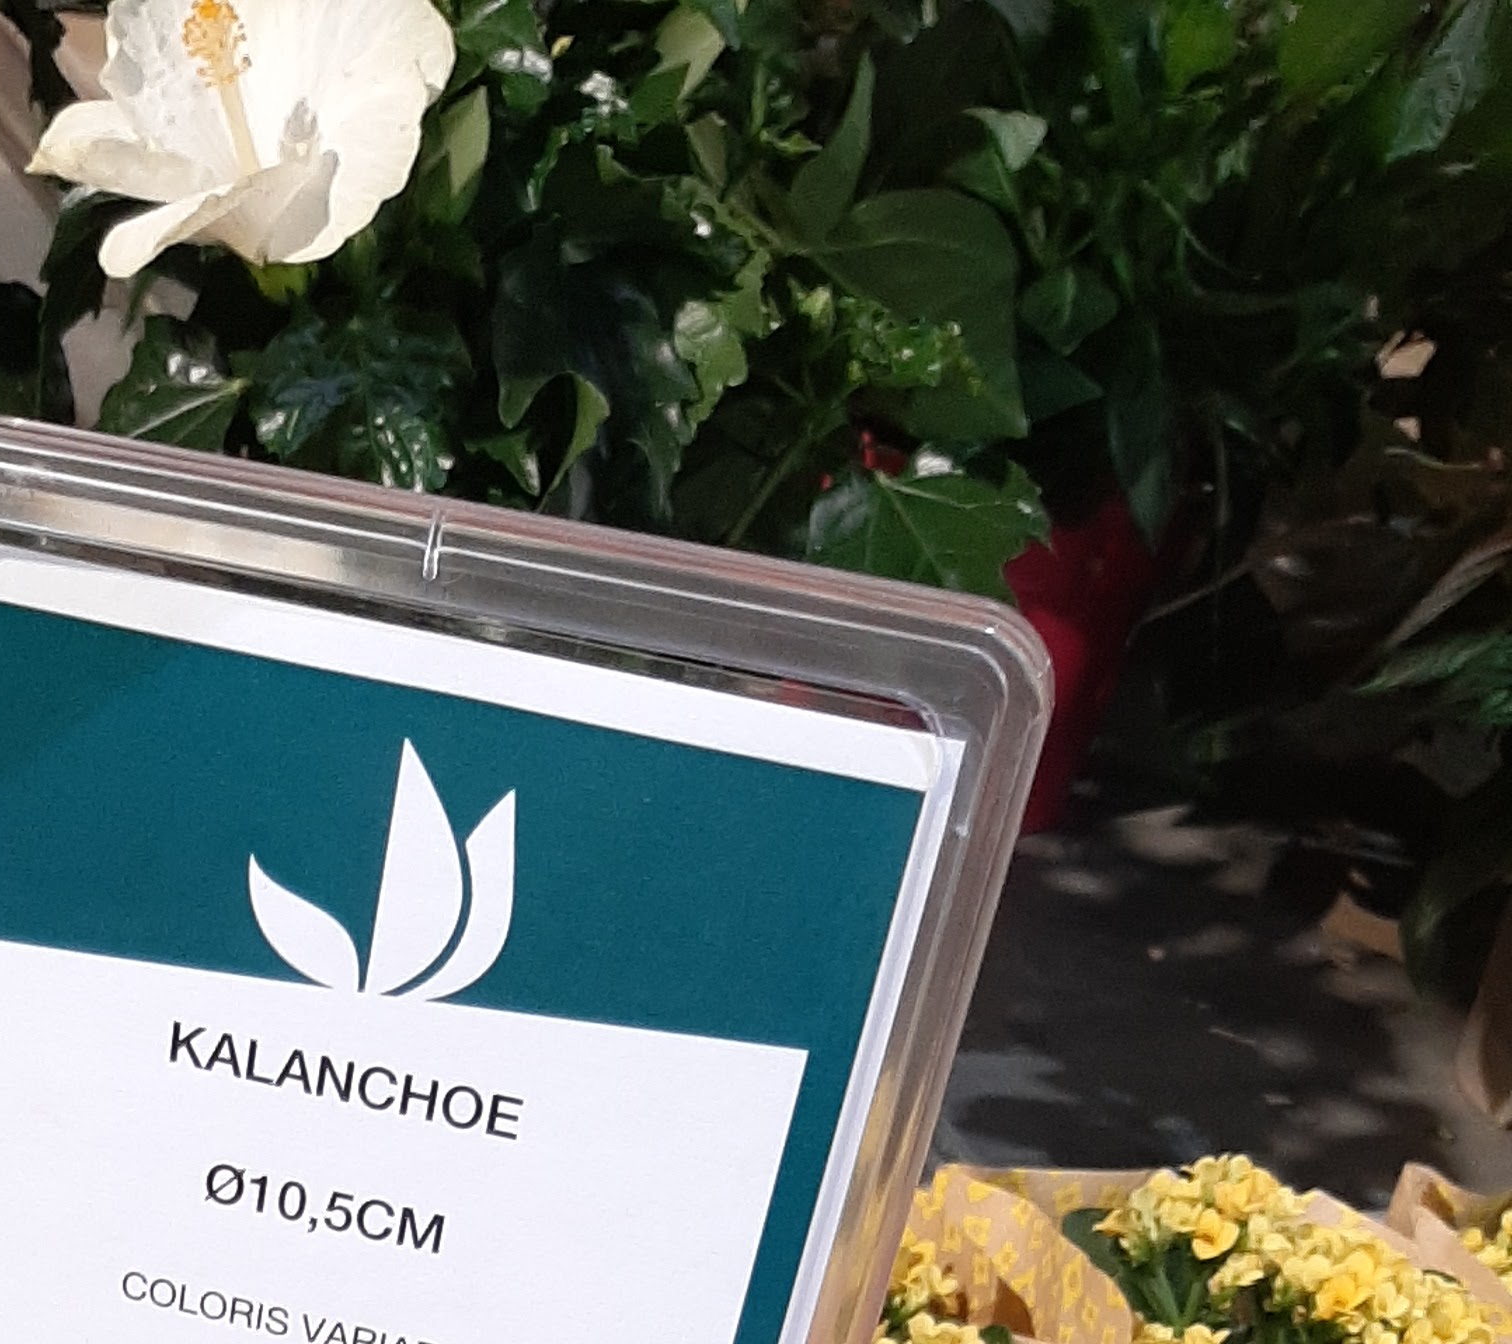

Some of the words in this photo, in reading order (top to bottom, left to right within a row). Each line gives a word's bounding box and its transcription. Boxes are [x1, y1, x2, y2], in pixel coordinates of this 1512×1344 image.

[169, 1021, 525, 1140] KALANCHOE
[205, 1164, 445, 1254] Ø10,5CM
[122, 1271, 289, 1336] COLORIS
